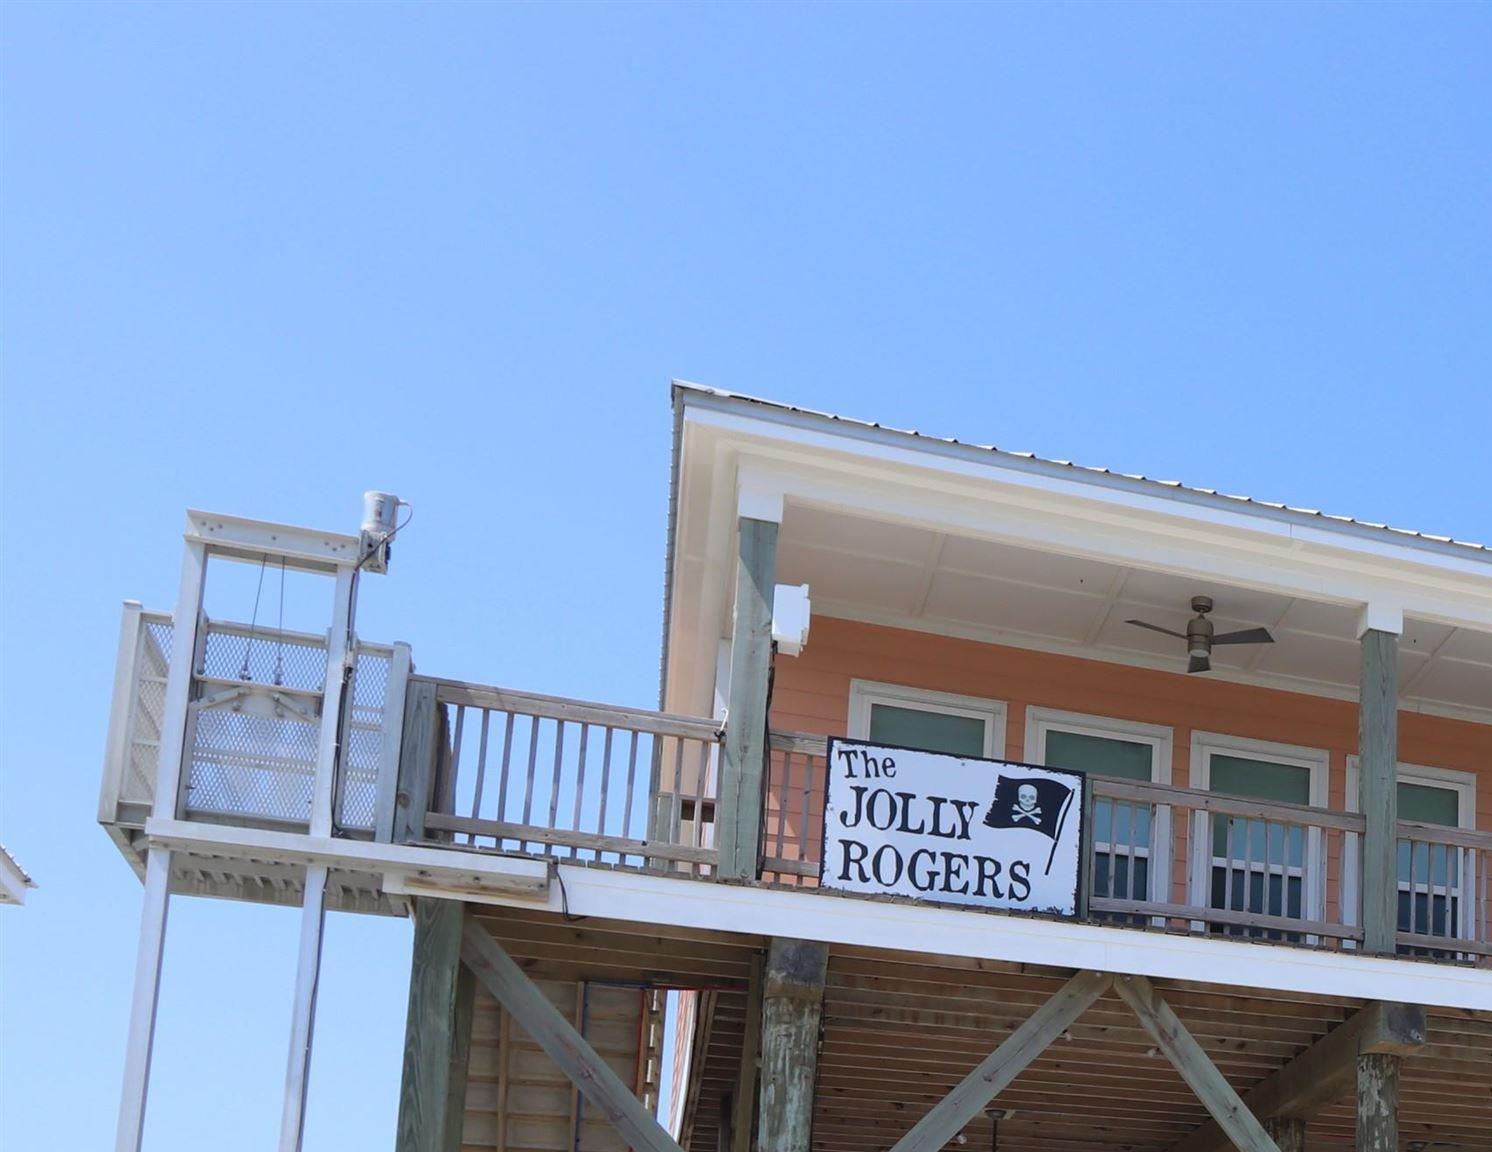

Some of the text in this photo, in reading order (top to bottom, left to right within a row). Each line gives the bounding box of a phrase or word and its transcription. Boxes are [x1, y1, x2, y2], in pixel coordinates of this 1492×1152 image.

[838, 749, 897, 779] The
[840, 786, 980, 840] JOLLY
[837, 839, 1032, 902] ROGERS
